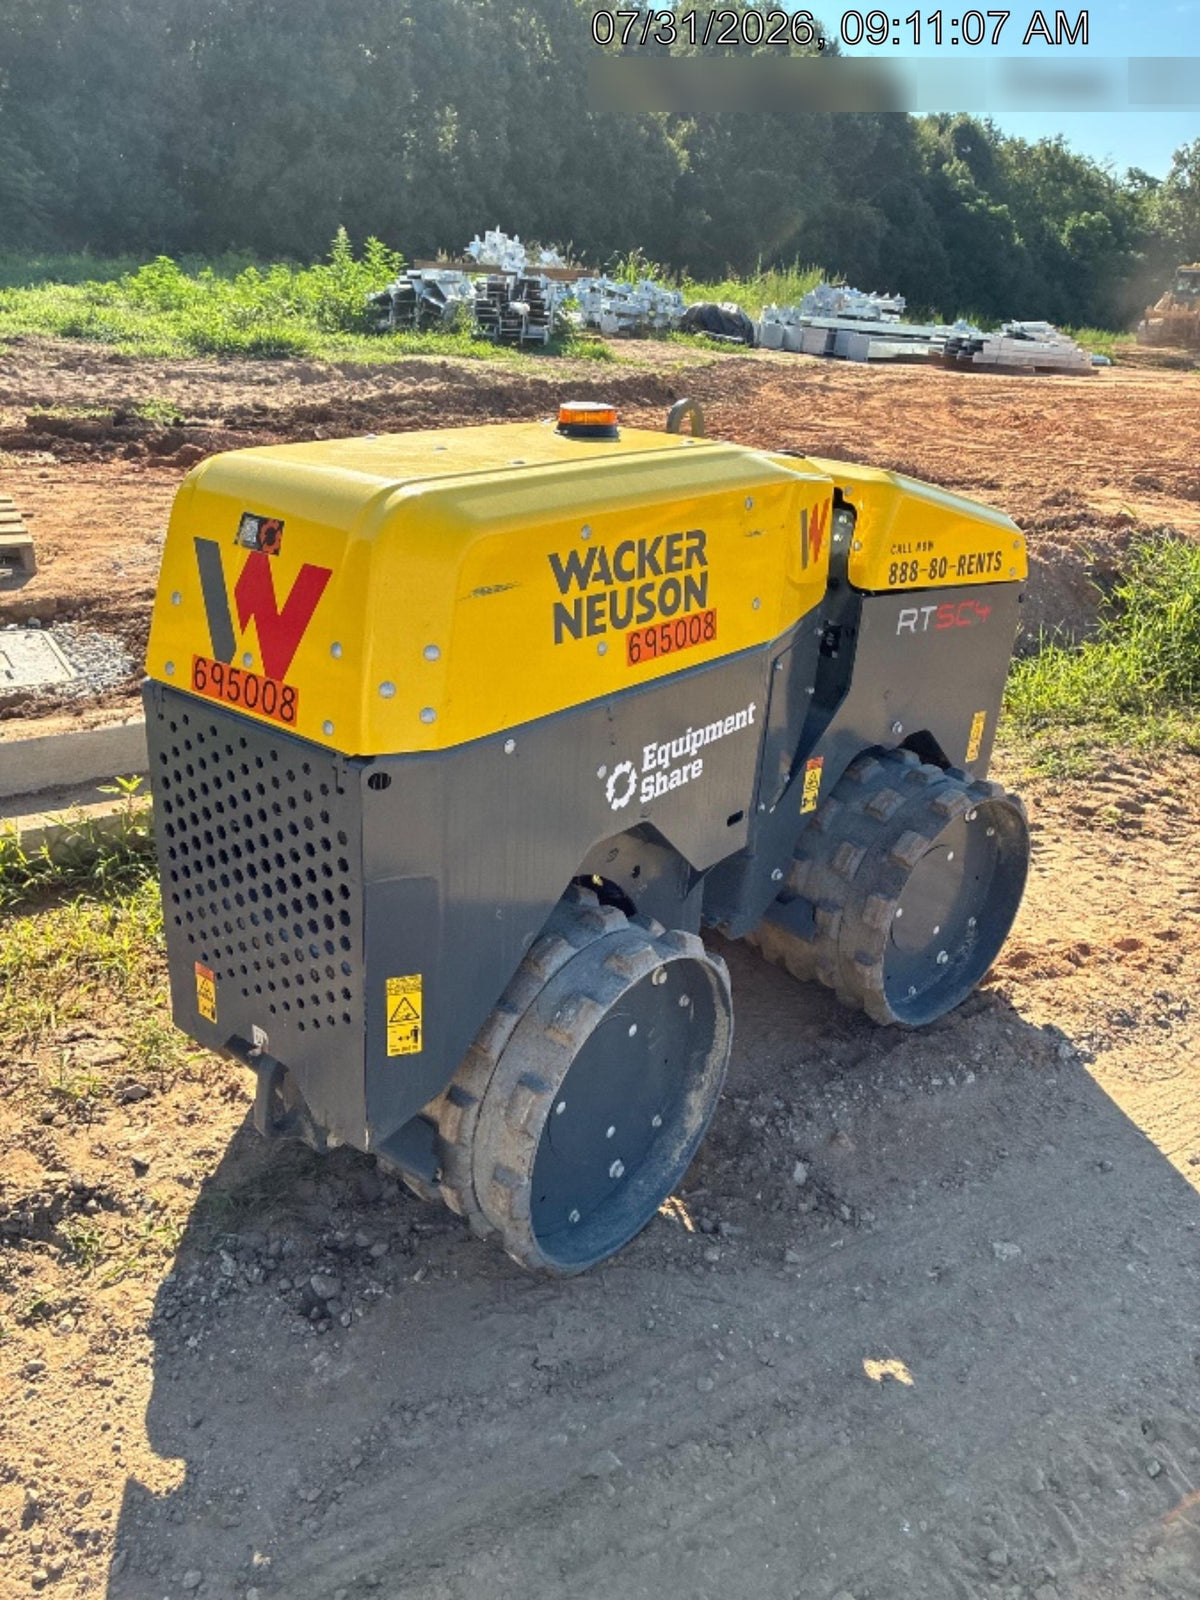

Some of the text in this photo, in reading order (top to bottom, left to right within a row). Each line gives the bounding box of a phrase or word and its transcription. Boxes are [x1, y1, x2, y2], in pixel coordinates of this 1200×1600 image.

[547, 529, 708, 595] WACKER
[888, 550, 1002, 585] 888-80-RENTS
[553, 570, 708, 645] NEUSON
[895, 599, 992, 635] RTSC4
[628, 611, 715, 664] 695008
[194, 657, 296, 723] 695008
[641, 702, 756, 772] Equipment
[639, 758, 703, 804] Share
